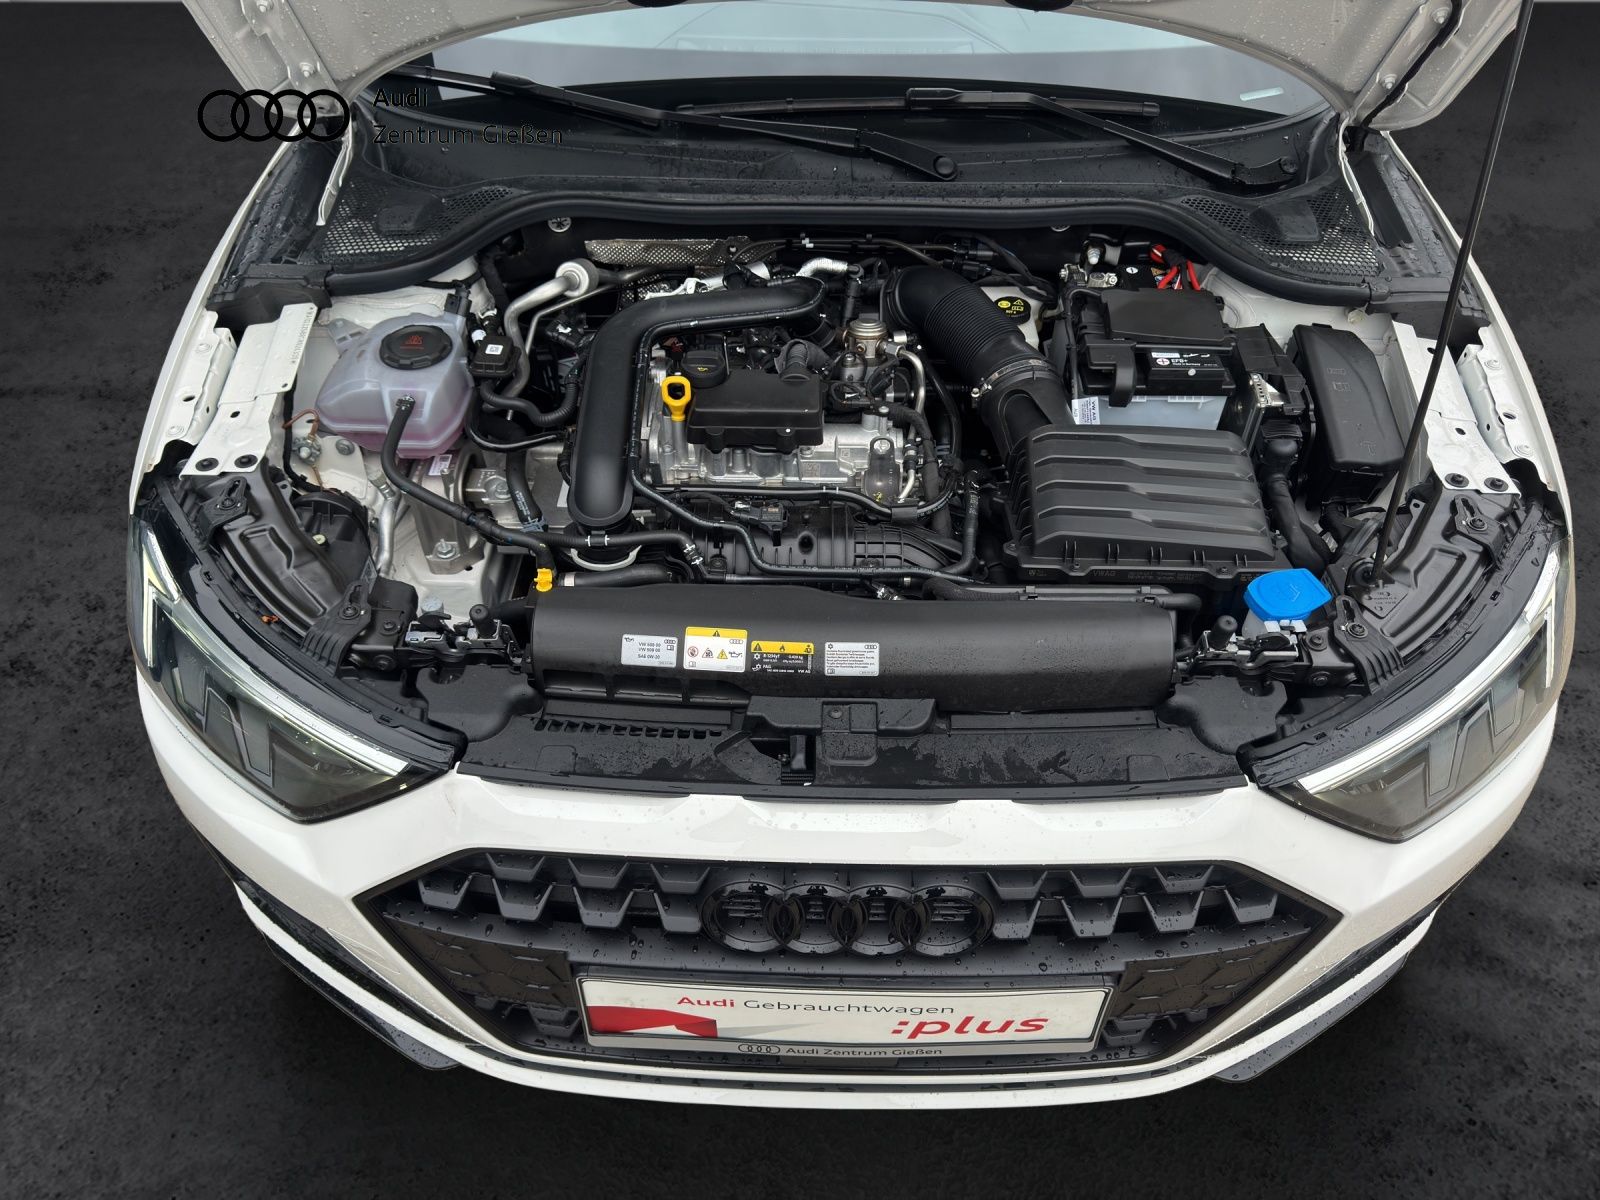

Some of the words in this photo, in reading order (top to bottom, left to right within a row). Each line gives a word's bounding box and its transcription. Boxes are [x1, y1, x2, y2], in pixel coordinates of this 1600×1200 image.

[677, 996, 736, 1008] Audi
[743, 999, 955, 1016] Gebrauchtwagen
[891, 1015, 1049, 1040] :plus
[785, 1047, 819, 1055] Audi
[823, 1048, 887, 1056] Zentrum
[892, 1048, 943, 1056] Gießen
